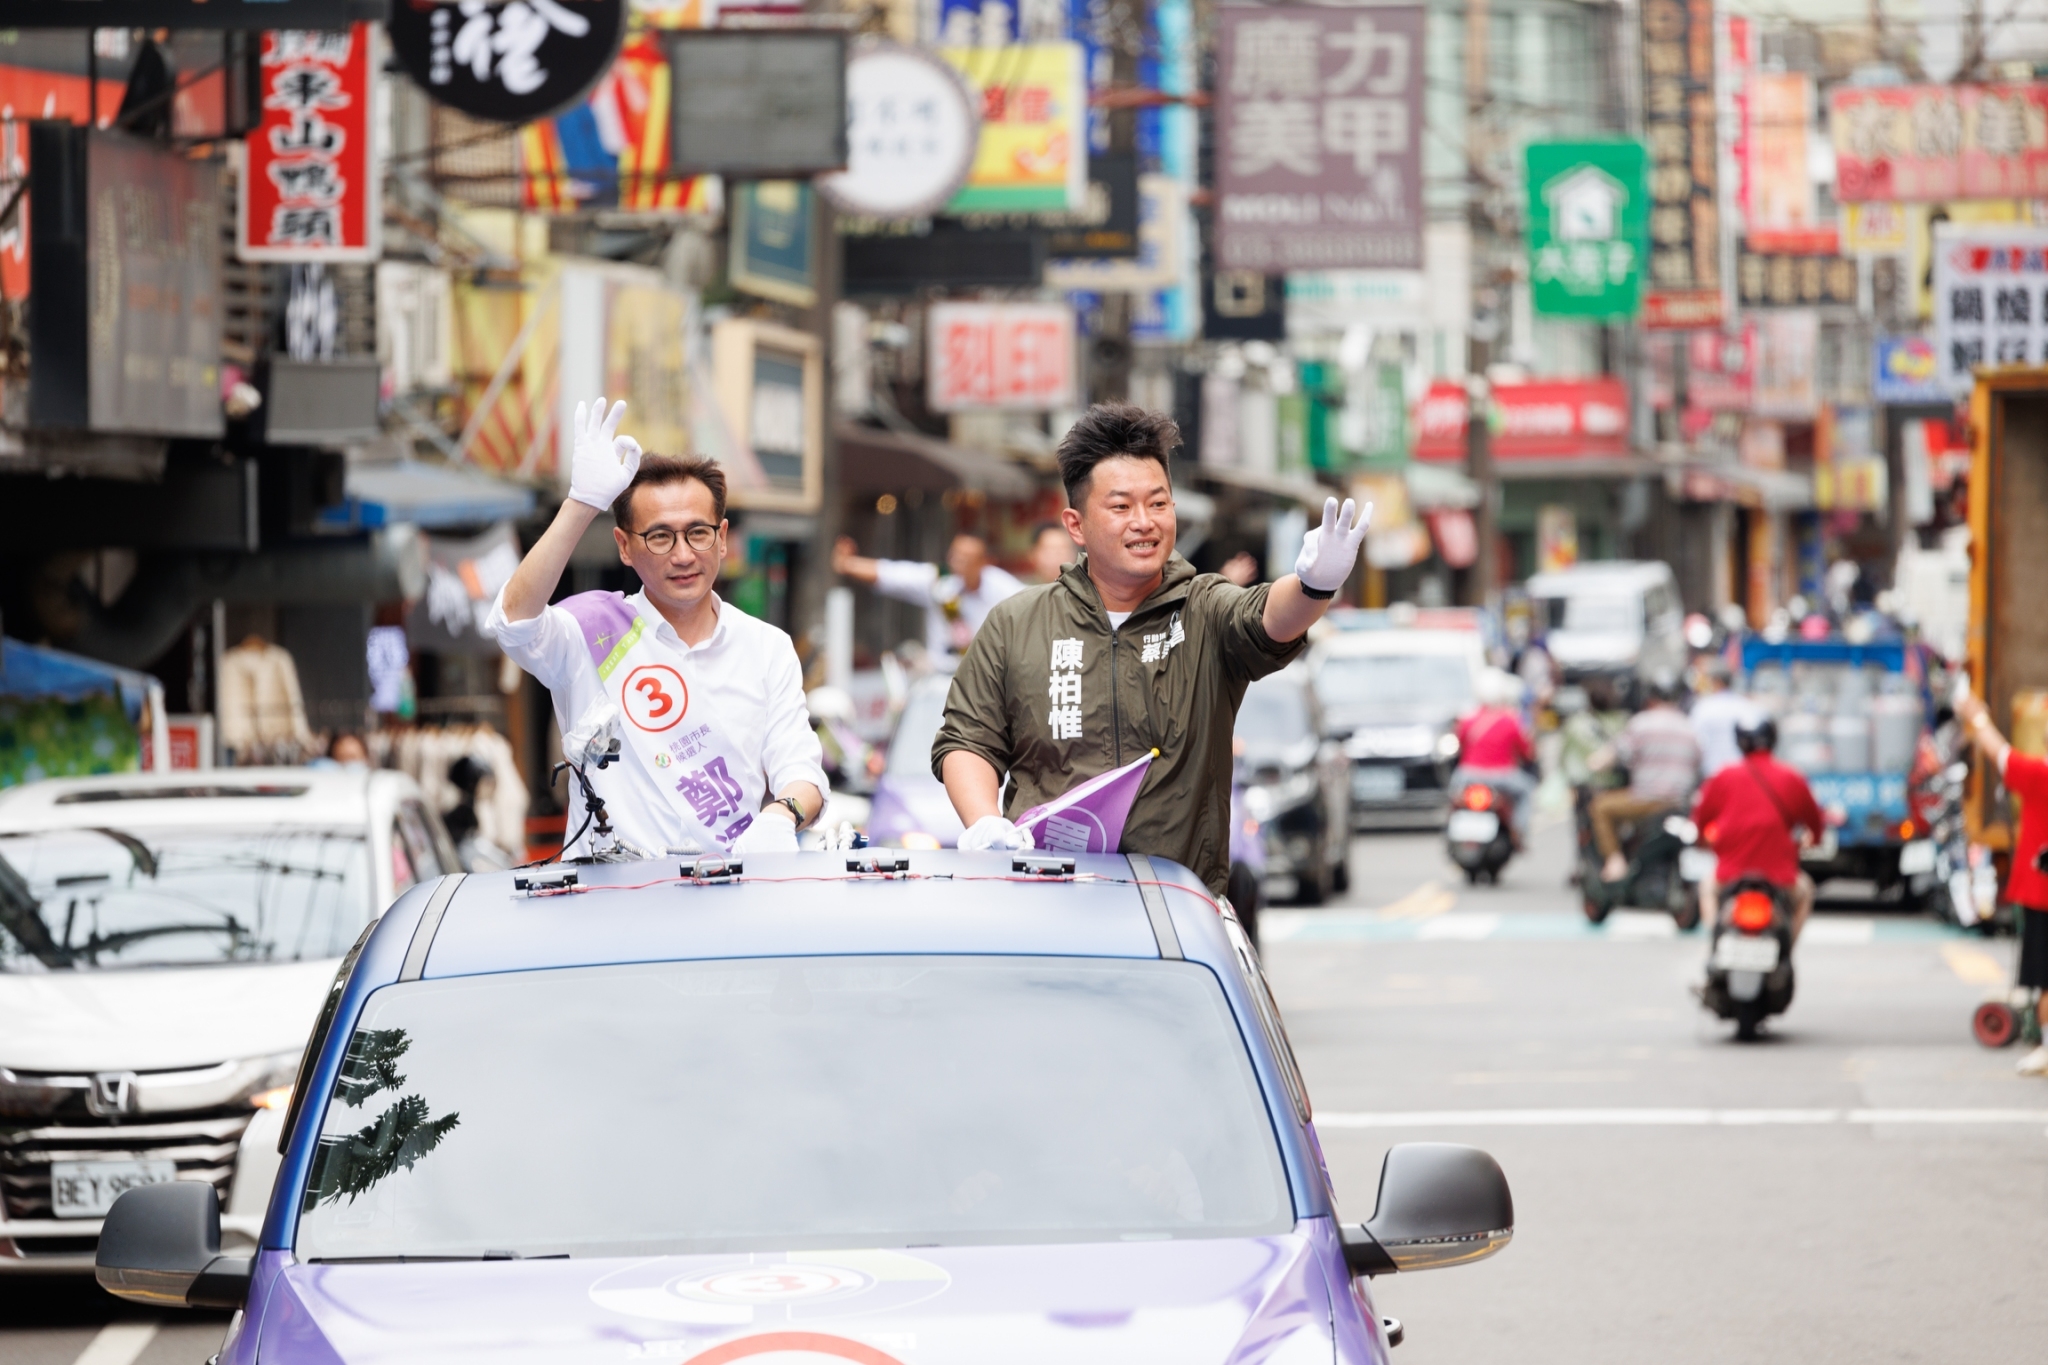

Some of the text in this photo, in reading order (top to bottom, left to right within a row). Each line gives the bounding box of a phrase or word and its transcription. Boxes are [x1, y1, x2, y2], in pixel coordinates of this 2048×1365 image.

[1228, 98, 1410, 177] 美甲
[1950, 286, 2048, 323] 鍋燒
[943, 321, 1064, 403] 刻印
[635, 677, 673, 718] 3
[1048, 637, 1084, 740] 陳柏惟
[669, 723, 711, 754] 桃園市長
[675, 741, 707, 764] 候選人
